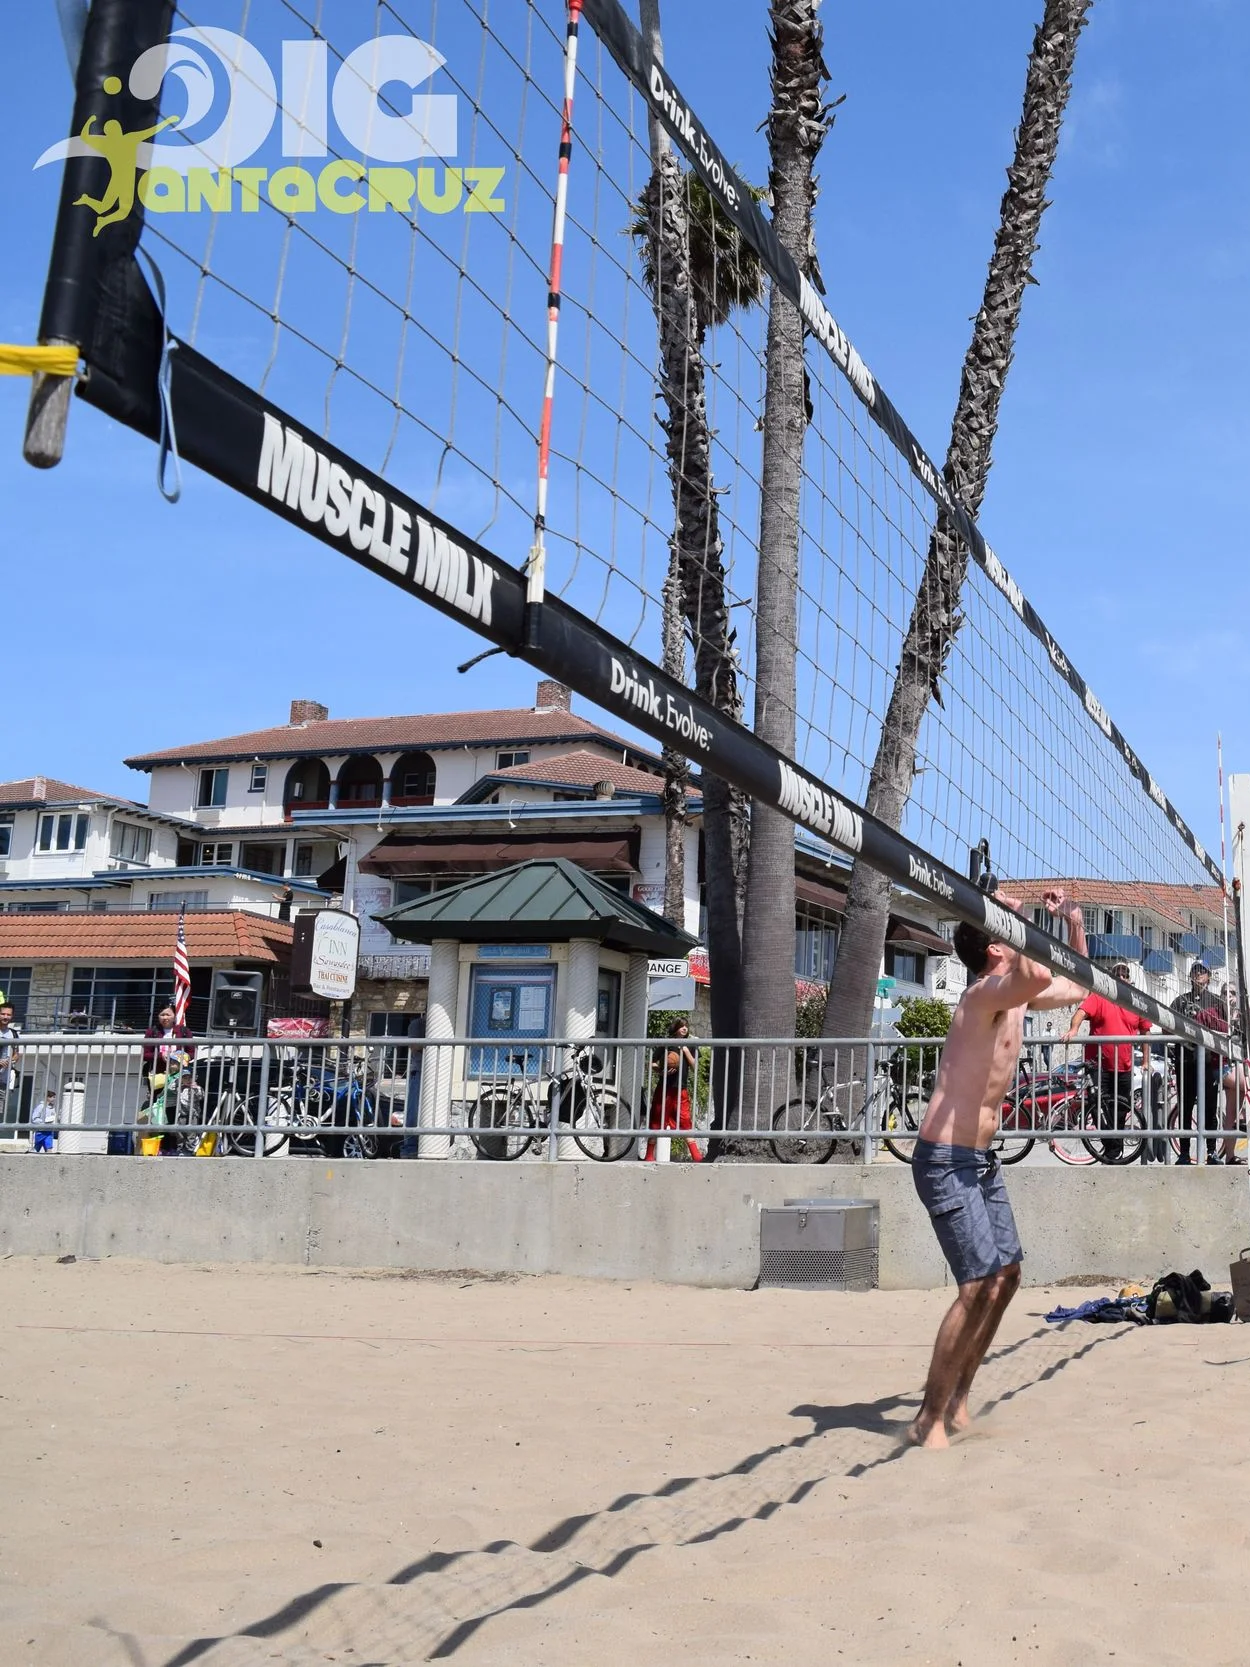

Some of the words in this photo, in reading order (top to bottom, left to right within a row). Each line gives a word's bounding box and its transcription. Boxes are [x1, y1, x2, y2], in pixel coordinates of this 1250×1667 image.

[651, 64, 699, 154] Drink.
[257, 411, 411, 576] MUSCLE
[413, 514, 493, 627] MILK
[610, 657, 664, 722] Drink.
[777, 759, 832, 834] MUSCLE
[329, 939, 348, 956] INN
[648, 963, 681, 974] ANGE
